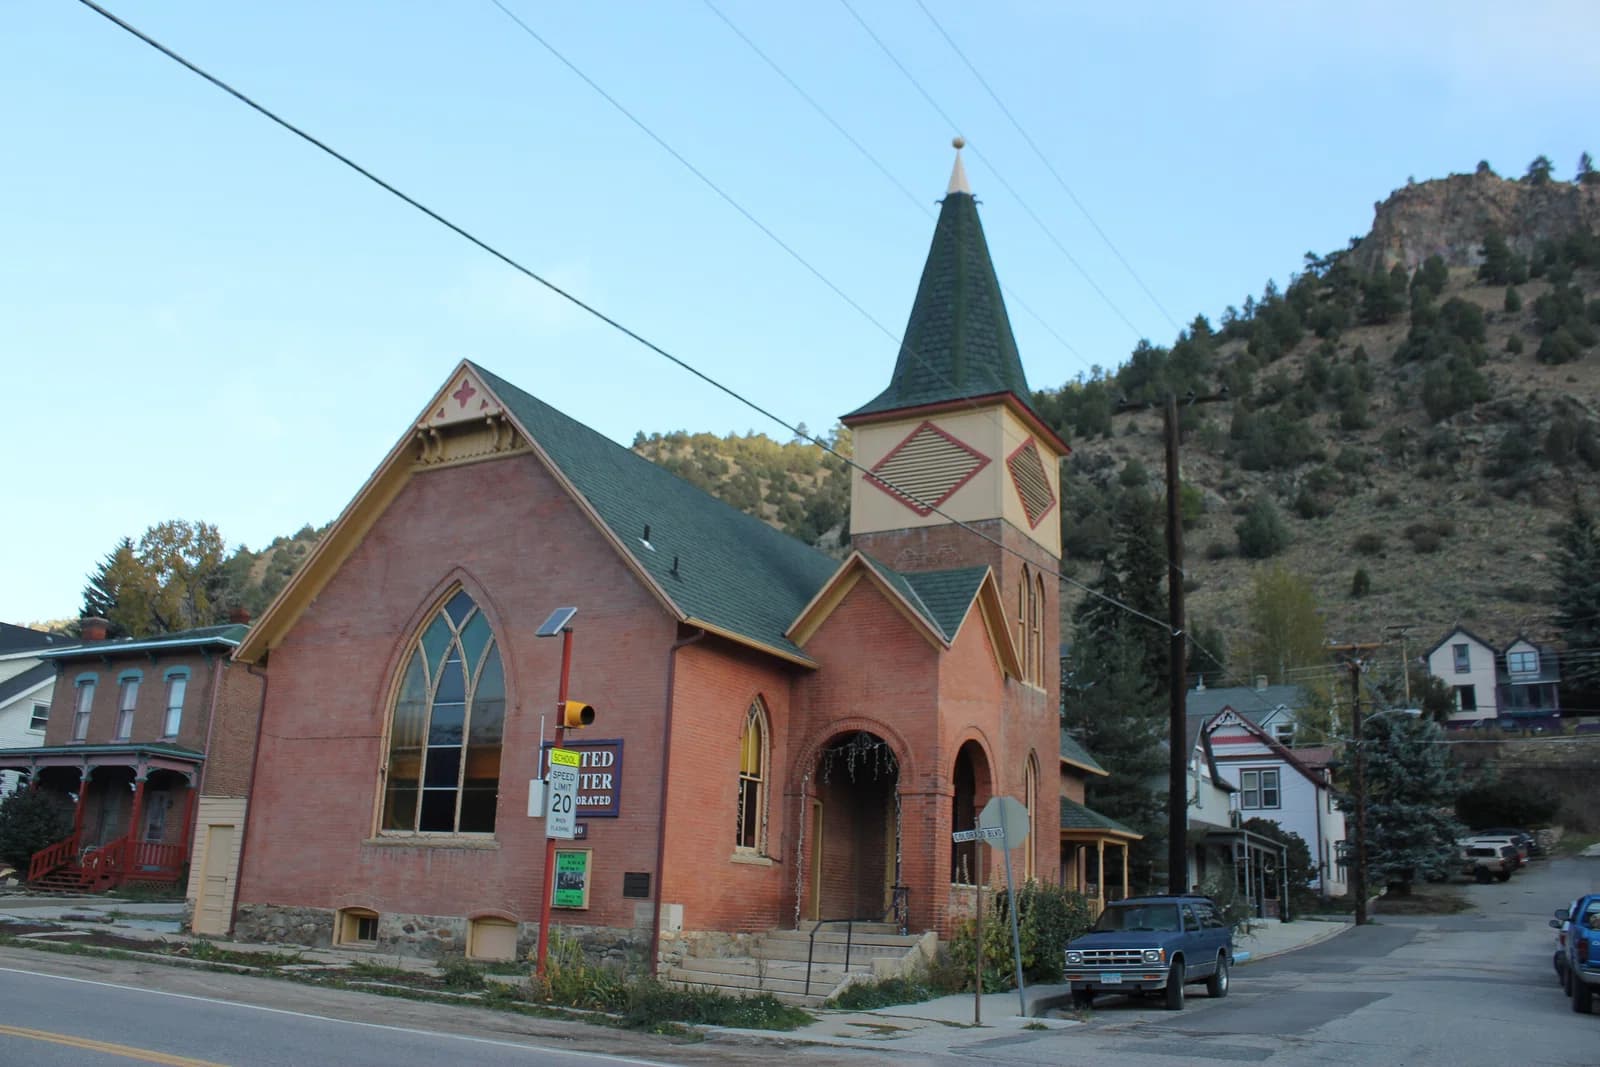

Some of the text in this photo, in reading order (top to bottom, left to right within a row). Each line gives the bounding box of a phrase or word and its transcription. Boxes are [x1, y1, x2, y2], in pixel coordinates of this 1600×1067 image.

[554, 753, 577, 765] SCHOOL
[553, 770, 575, 782] SPEED
[554, 782, 572, 792] LIMIT
[552, 792, 572, 814] 20
[575, 795, 611, 806] ORATED
